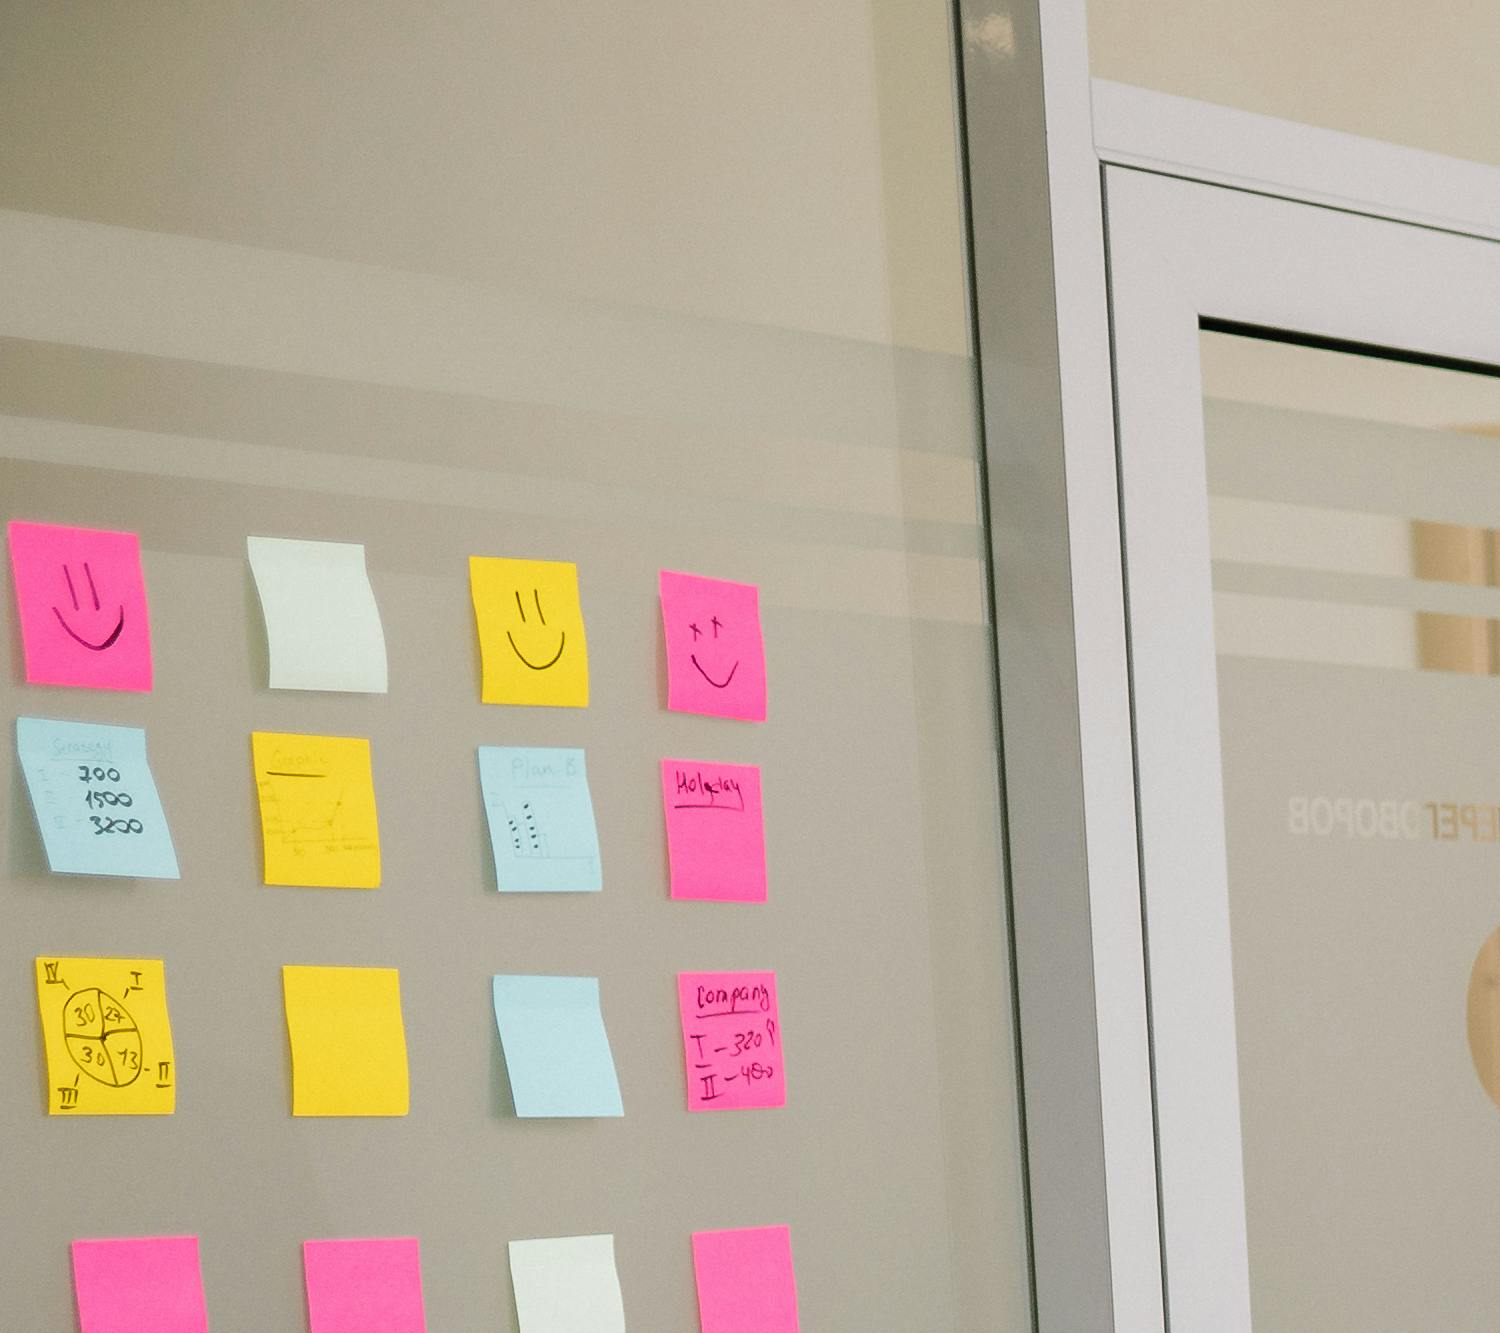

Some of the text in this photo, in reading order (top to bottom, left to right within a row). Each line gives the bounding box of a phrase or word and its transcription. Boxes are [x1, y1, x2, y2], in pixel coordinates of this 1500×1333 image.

[85, 790, 133, 810] 1500
[89, 815, 144, 836] 3200
[44, 961, 63, 984] IV
[697, 983, 770, 1012] Company
[74, 1003, 95, 1026] 30
[81, 1046, 105, 1067] 30
[117, 1048, 138, 1070] 13
[57, 1087, 79, 1110] III
